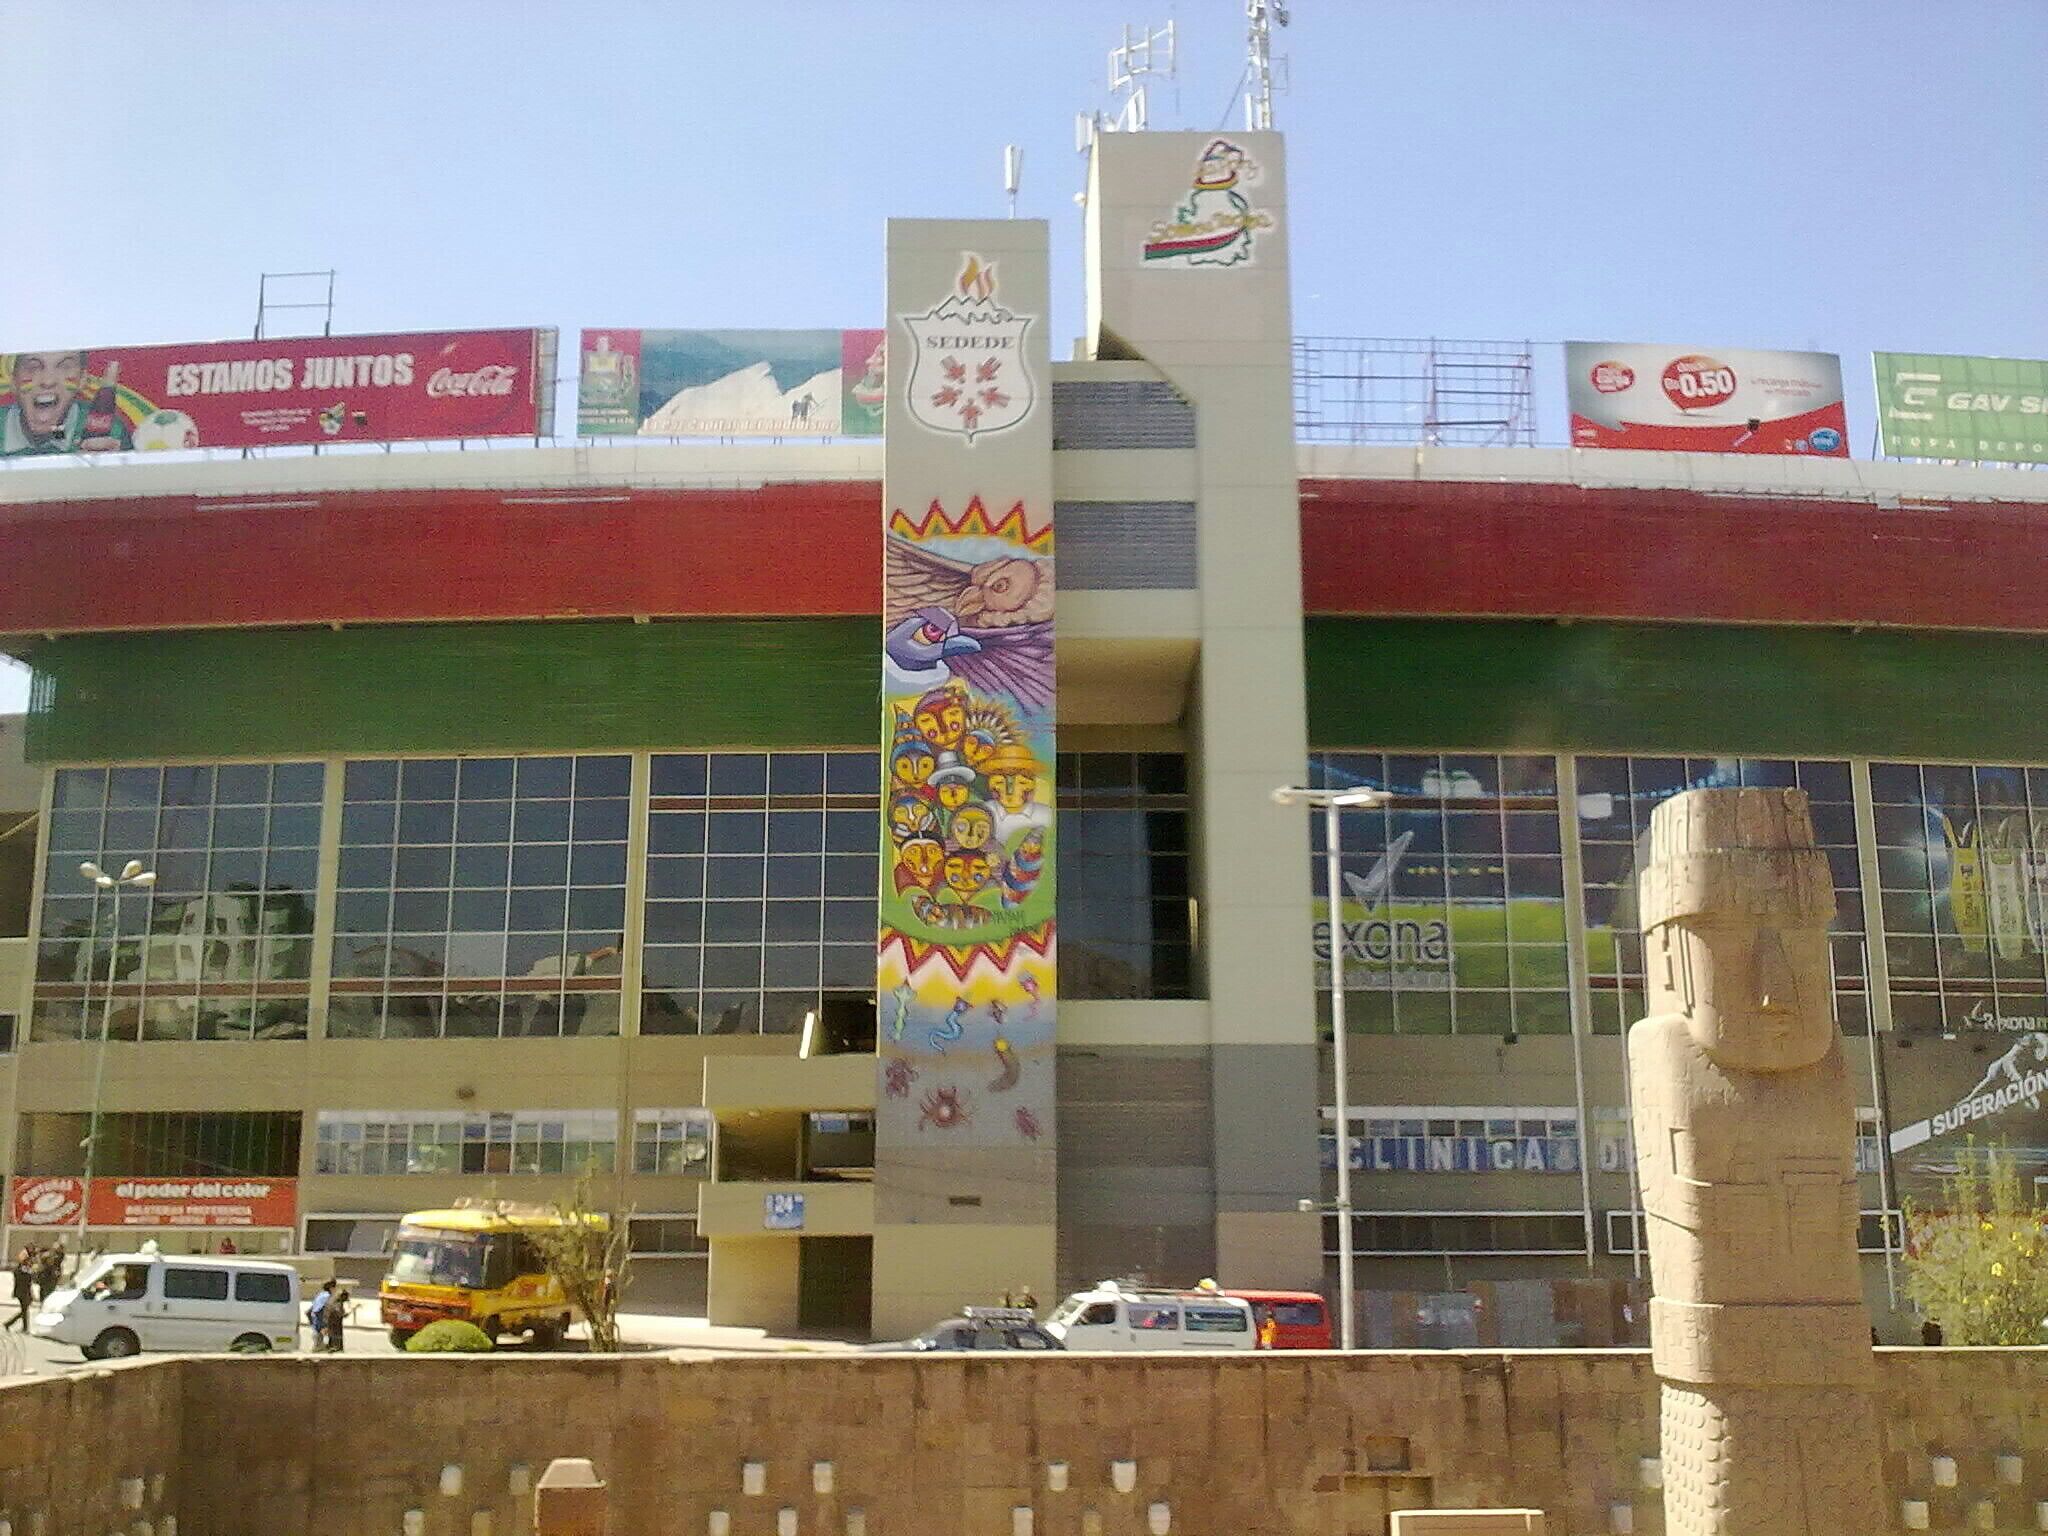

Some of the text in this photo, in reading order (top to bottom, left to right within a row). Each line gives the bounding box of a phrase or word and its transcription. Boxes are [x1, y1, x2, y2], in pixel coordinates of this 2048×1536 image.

[927, 336, 1015, 348] SEDEDE
[166, 353, 415, 397] ESTAMOS JUNTOS
[1678, 370, 1735, 399] 0.50
[1947, 393, 2011, 411] GAV
[1932, 1068, 2048, 1136] SUPERACIÓN
[1345, 1137, 1547, 1170] CLINICA
[116, 1183, 270, 1200] el poder del color
